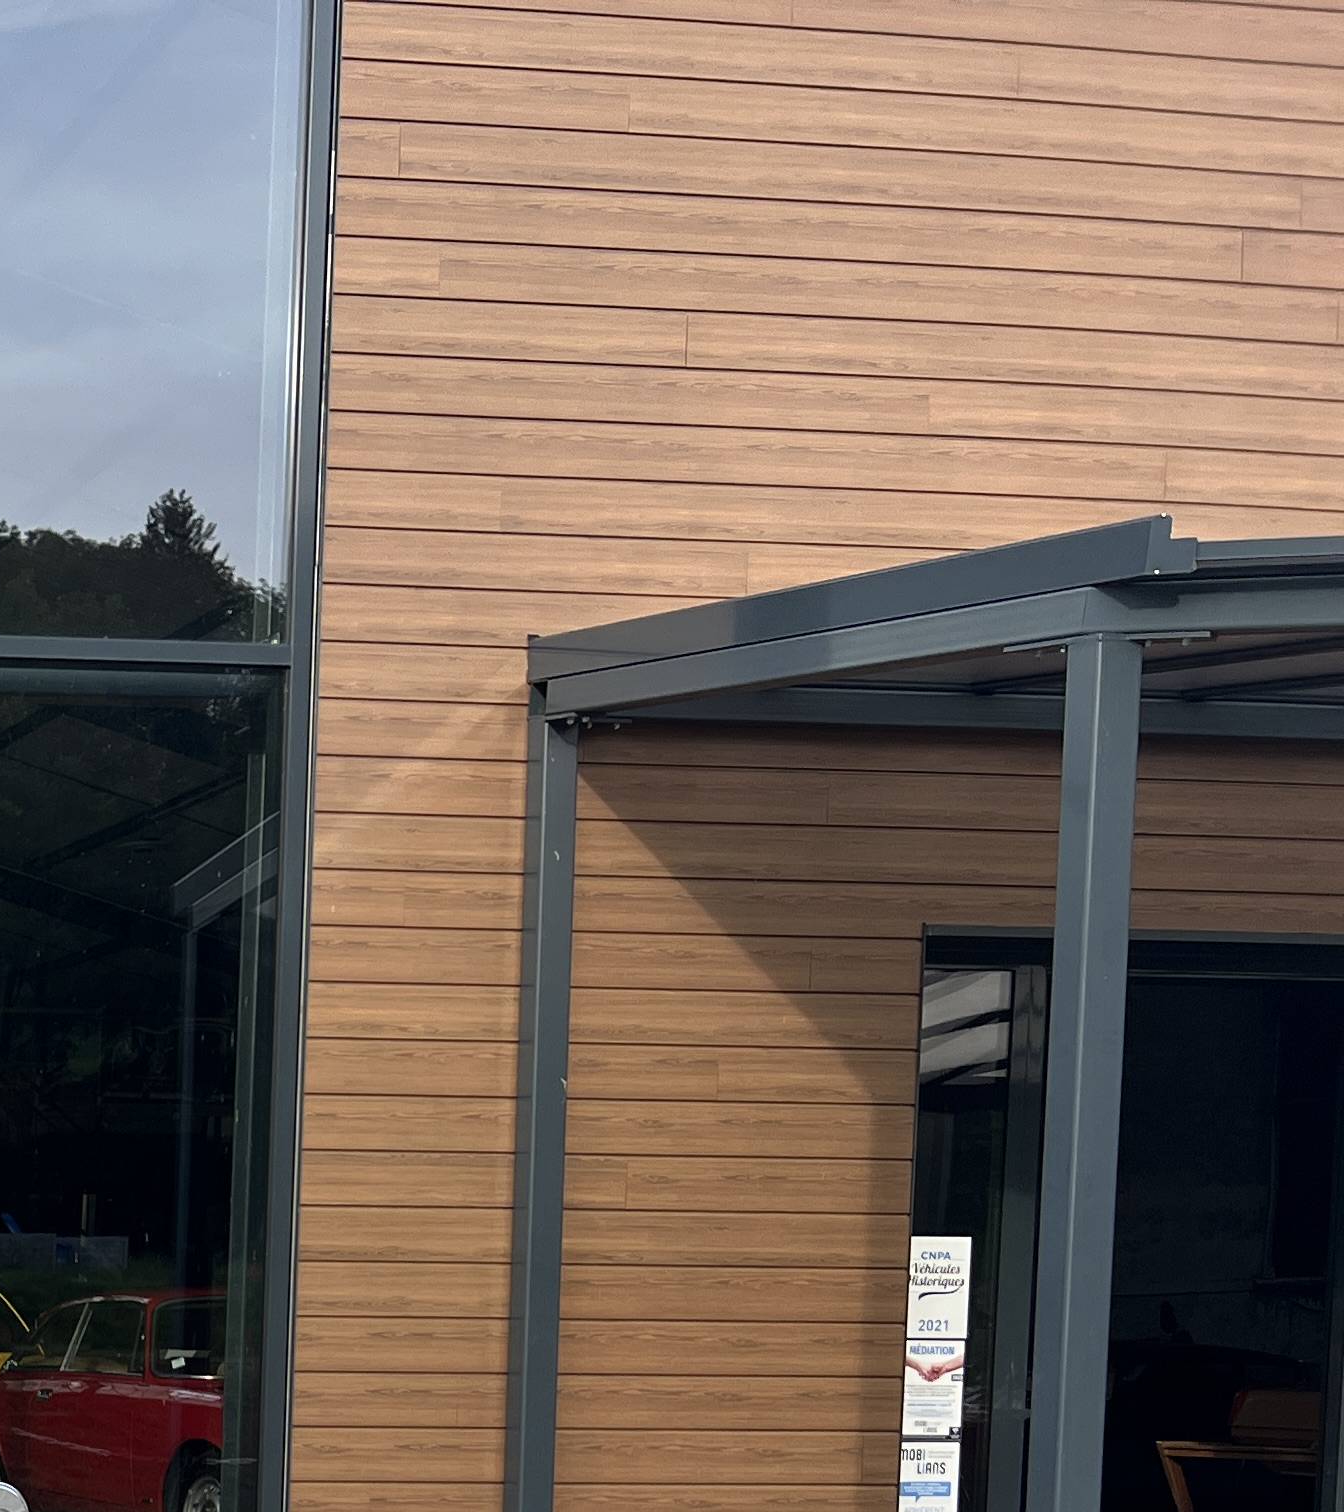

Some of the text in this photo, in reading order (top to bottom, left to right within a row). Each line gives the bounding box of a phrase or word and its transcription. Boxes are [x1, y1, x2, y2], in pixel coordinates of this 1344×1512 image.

[920, 1251, 952, 1261] CNPA
[918, 1319, 950, 1332] 2021
[909, 1342, 955, 1355] MÉDIATION
